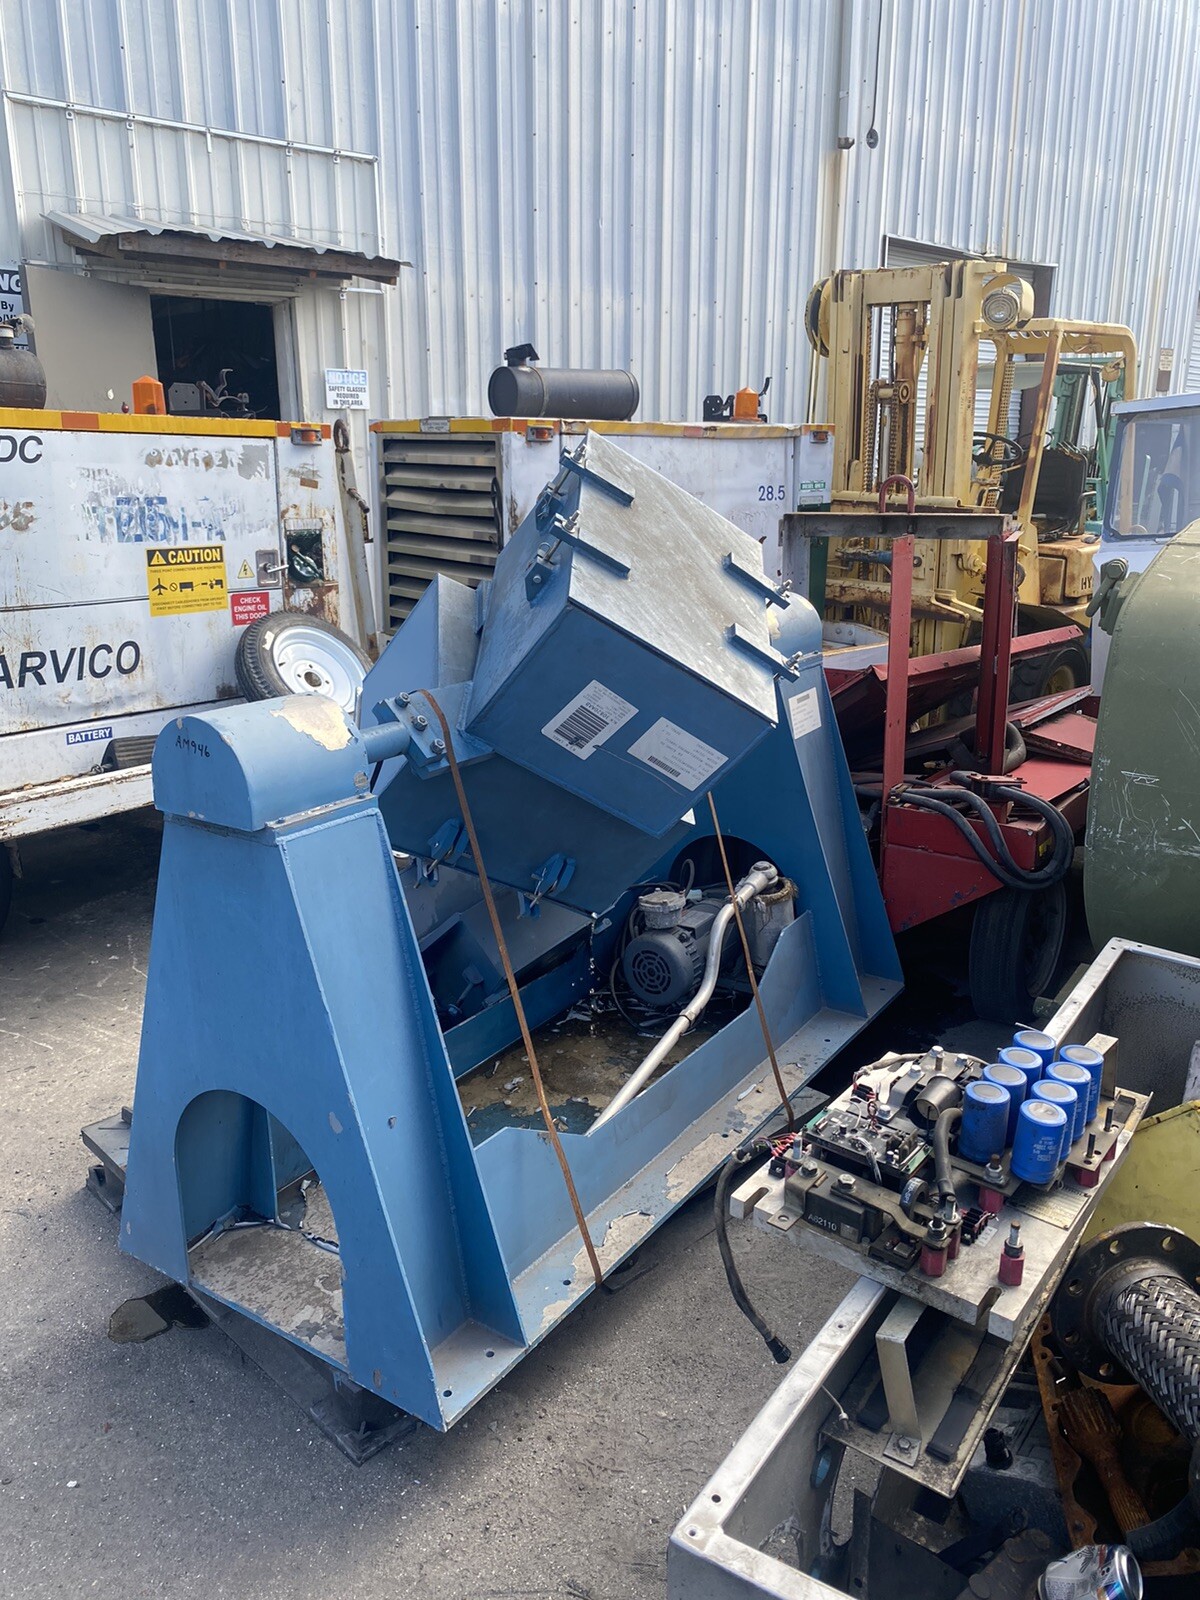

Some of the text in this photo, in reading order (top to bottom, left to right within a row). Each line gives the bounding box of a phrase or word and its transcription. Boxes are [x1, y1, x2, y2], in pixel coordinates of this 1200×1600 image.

[758, 485, 786, 501] 28.5
[168, 548, 221, 564] CAUTION
[240, 596, 261, 604] CHECK
[68, 727, 111, 744] BATTERY
[175, 735, 211, 758] AM946
